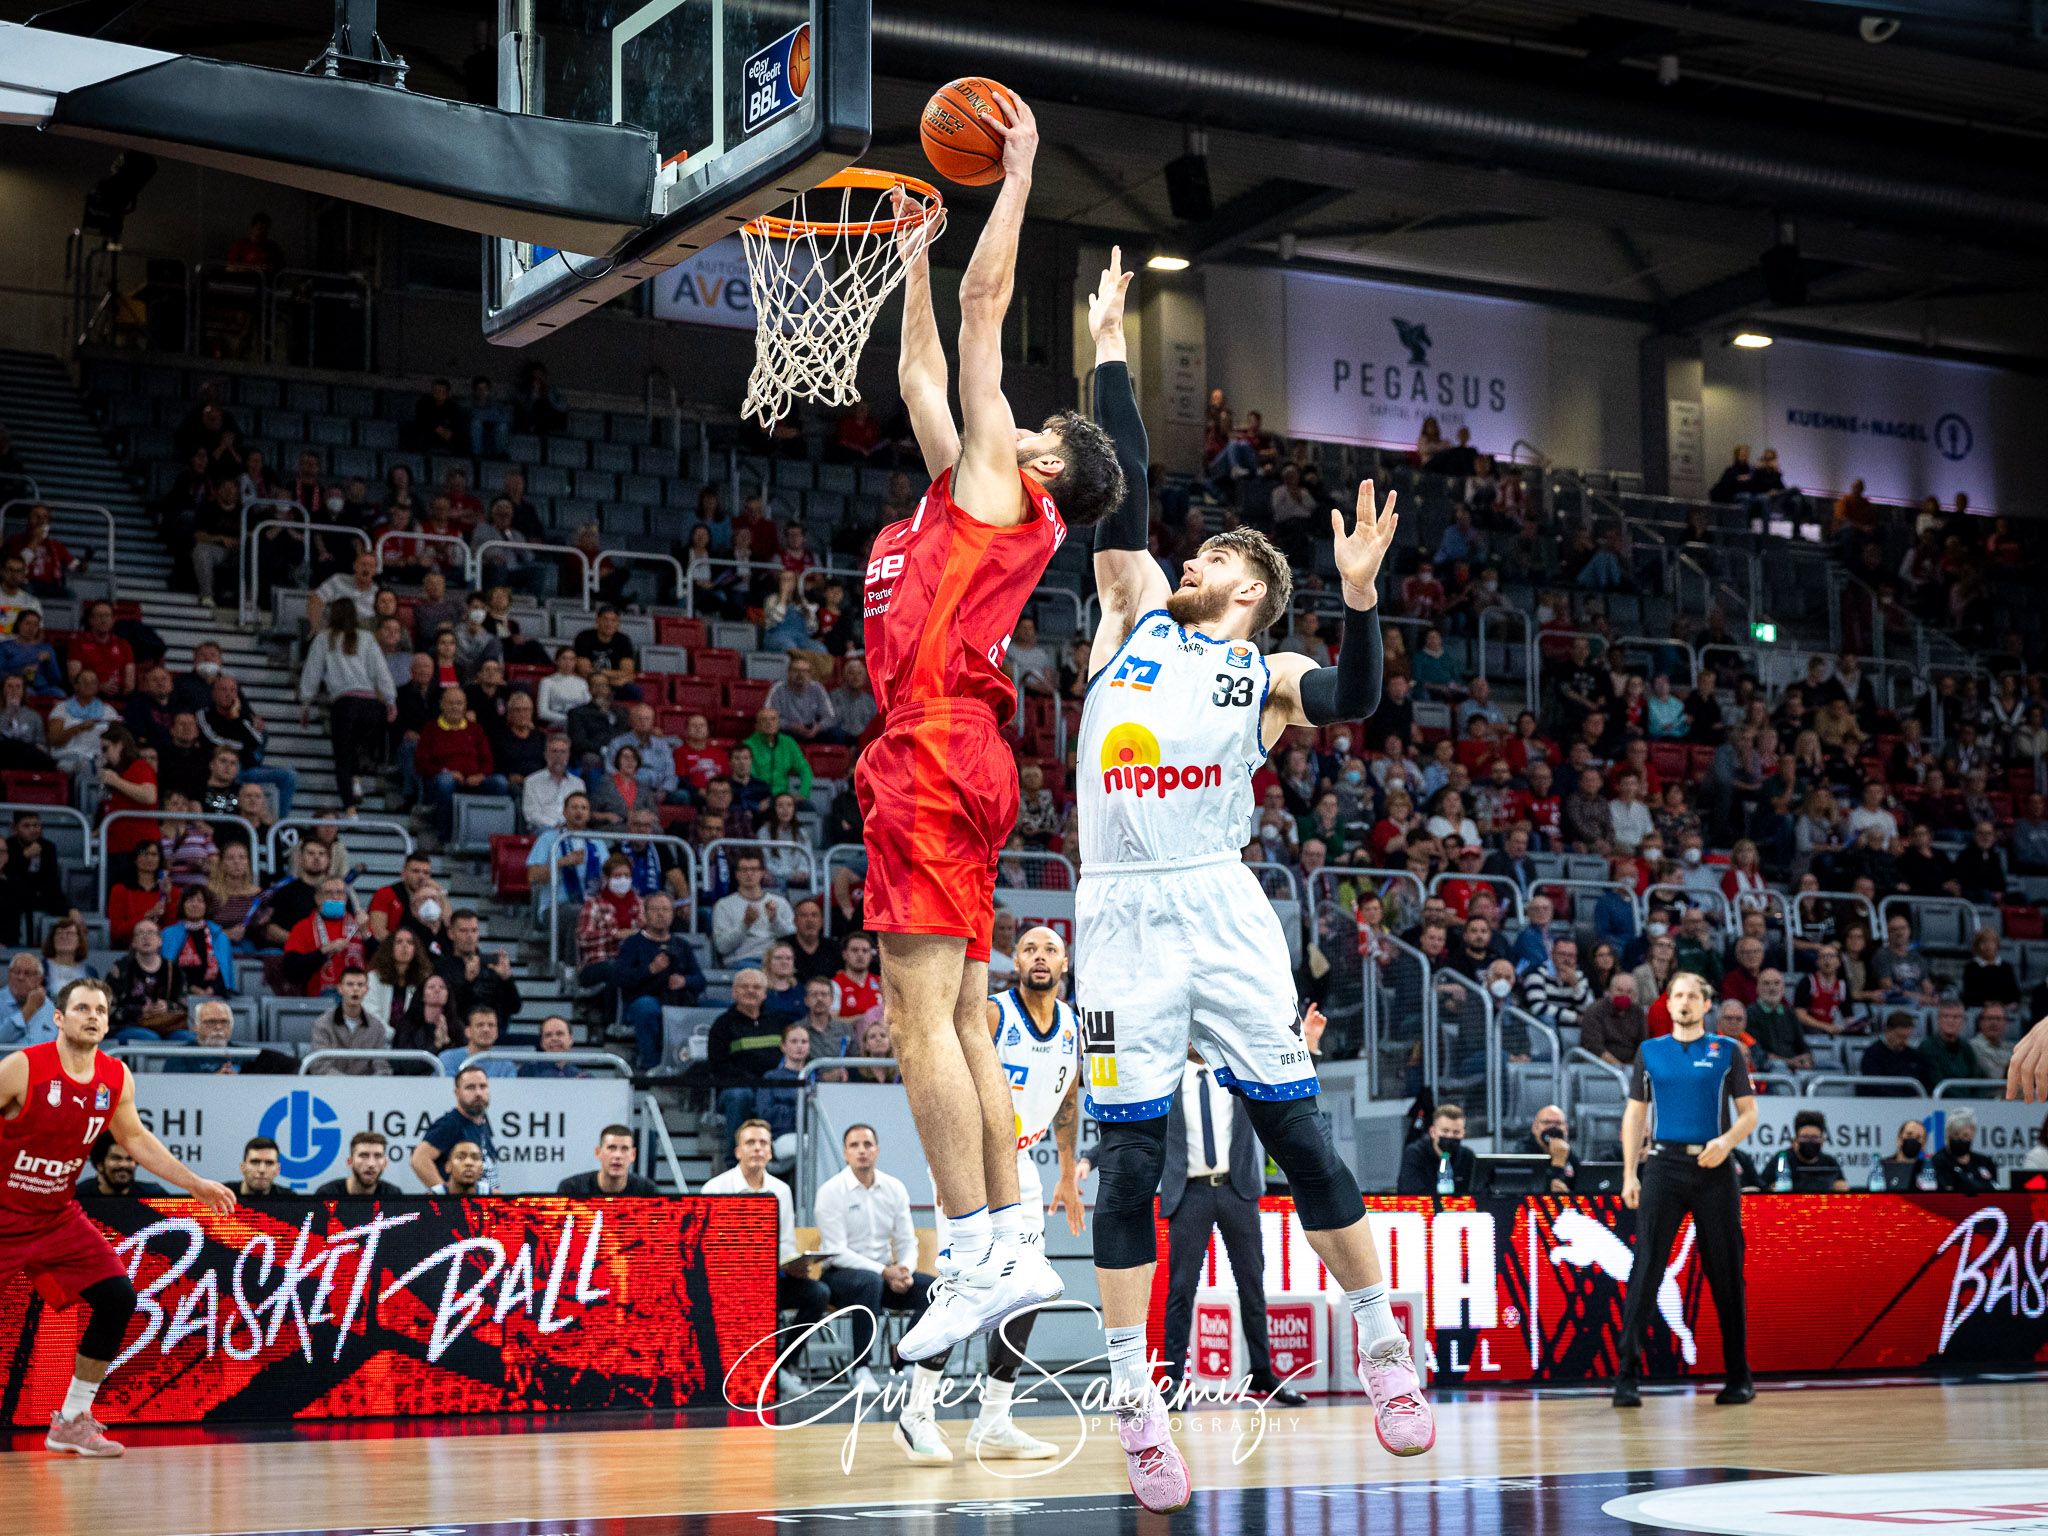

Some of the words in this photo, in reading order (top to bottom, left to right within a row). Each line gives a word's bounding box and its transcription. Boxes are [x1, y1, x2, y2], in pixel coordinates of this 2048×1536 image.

[758, 62, 781, 86] Credit
[749, 81, 781, 123] BBL
[1334, 359, 1506, 413] PEGASUS
[1212, 673, 1254, 707] 33
[1104, 764, 1221, 799] nippon
[1281, 1053, 1296, 1066] DER
[1055, 1066, 1067, 1094] 3
[83, 1116, 105, 1145] 17
[497, 1145, 566, 1163] GMBH
[105, 1211, 422, 1378] BASKET
[378, 1209, 611, 1363] BALL
[1268, 1336, 1310, 1350] PRUDEL
